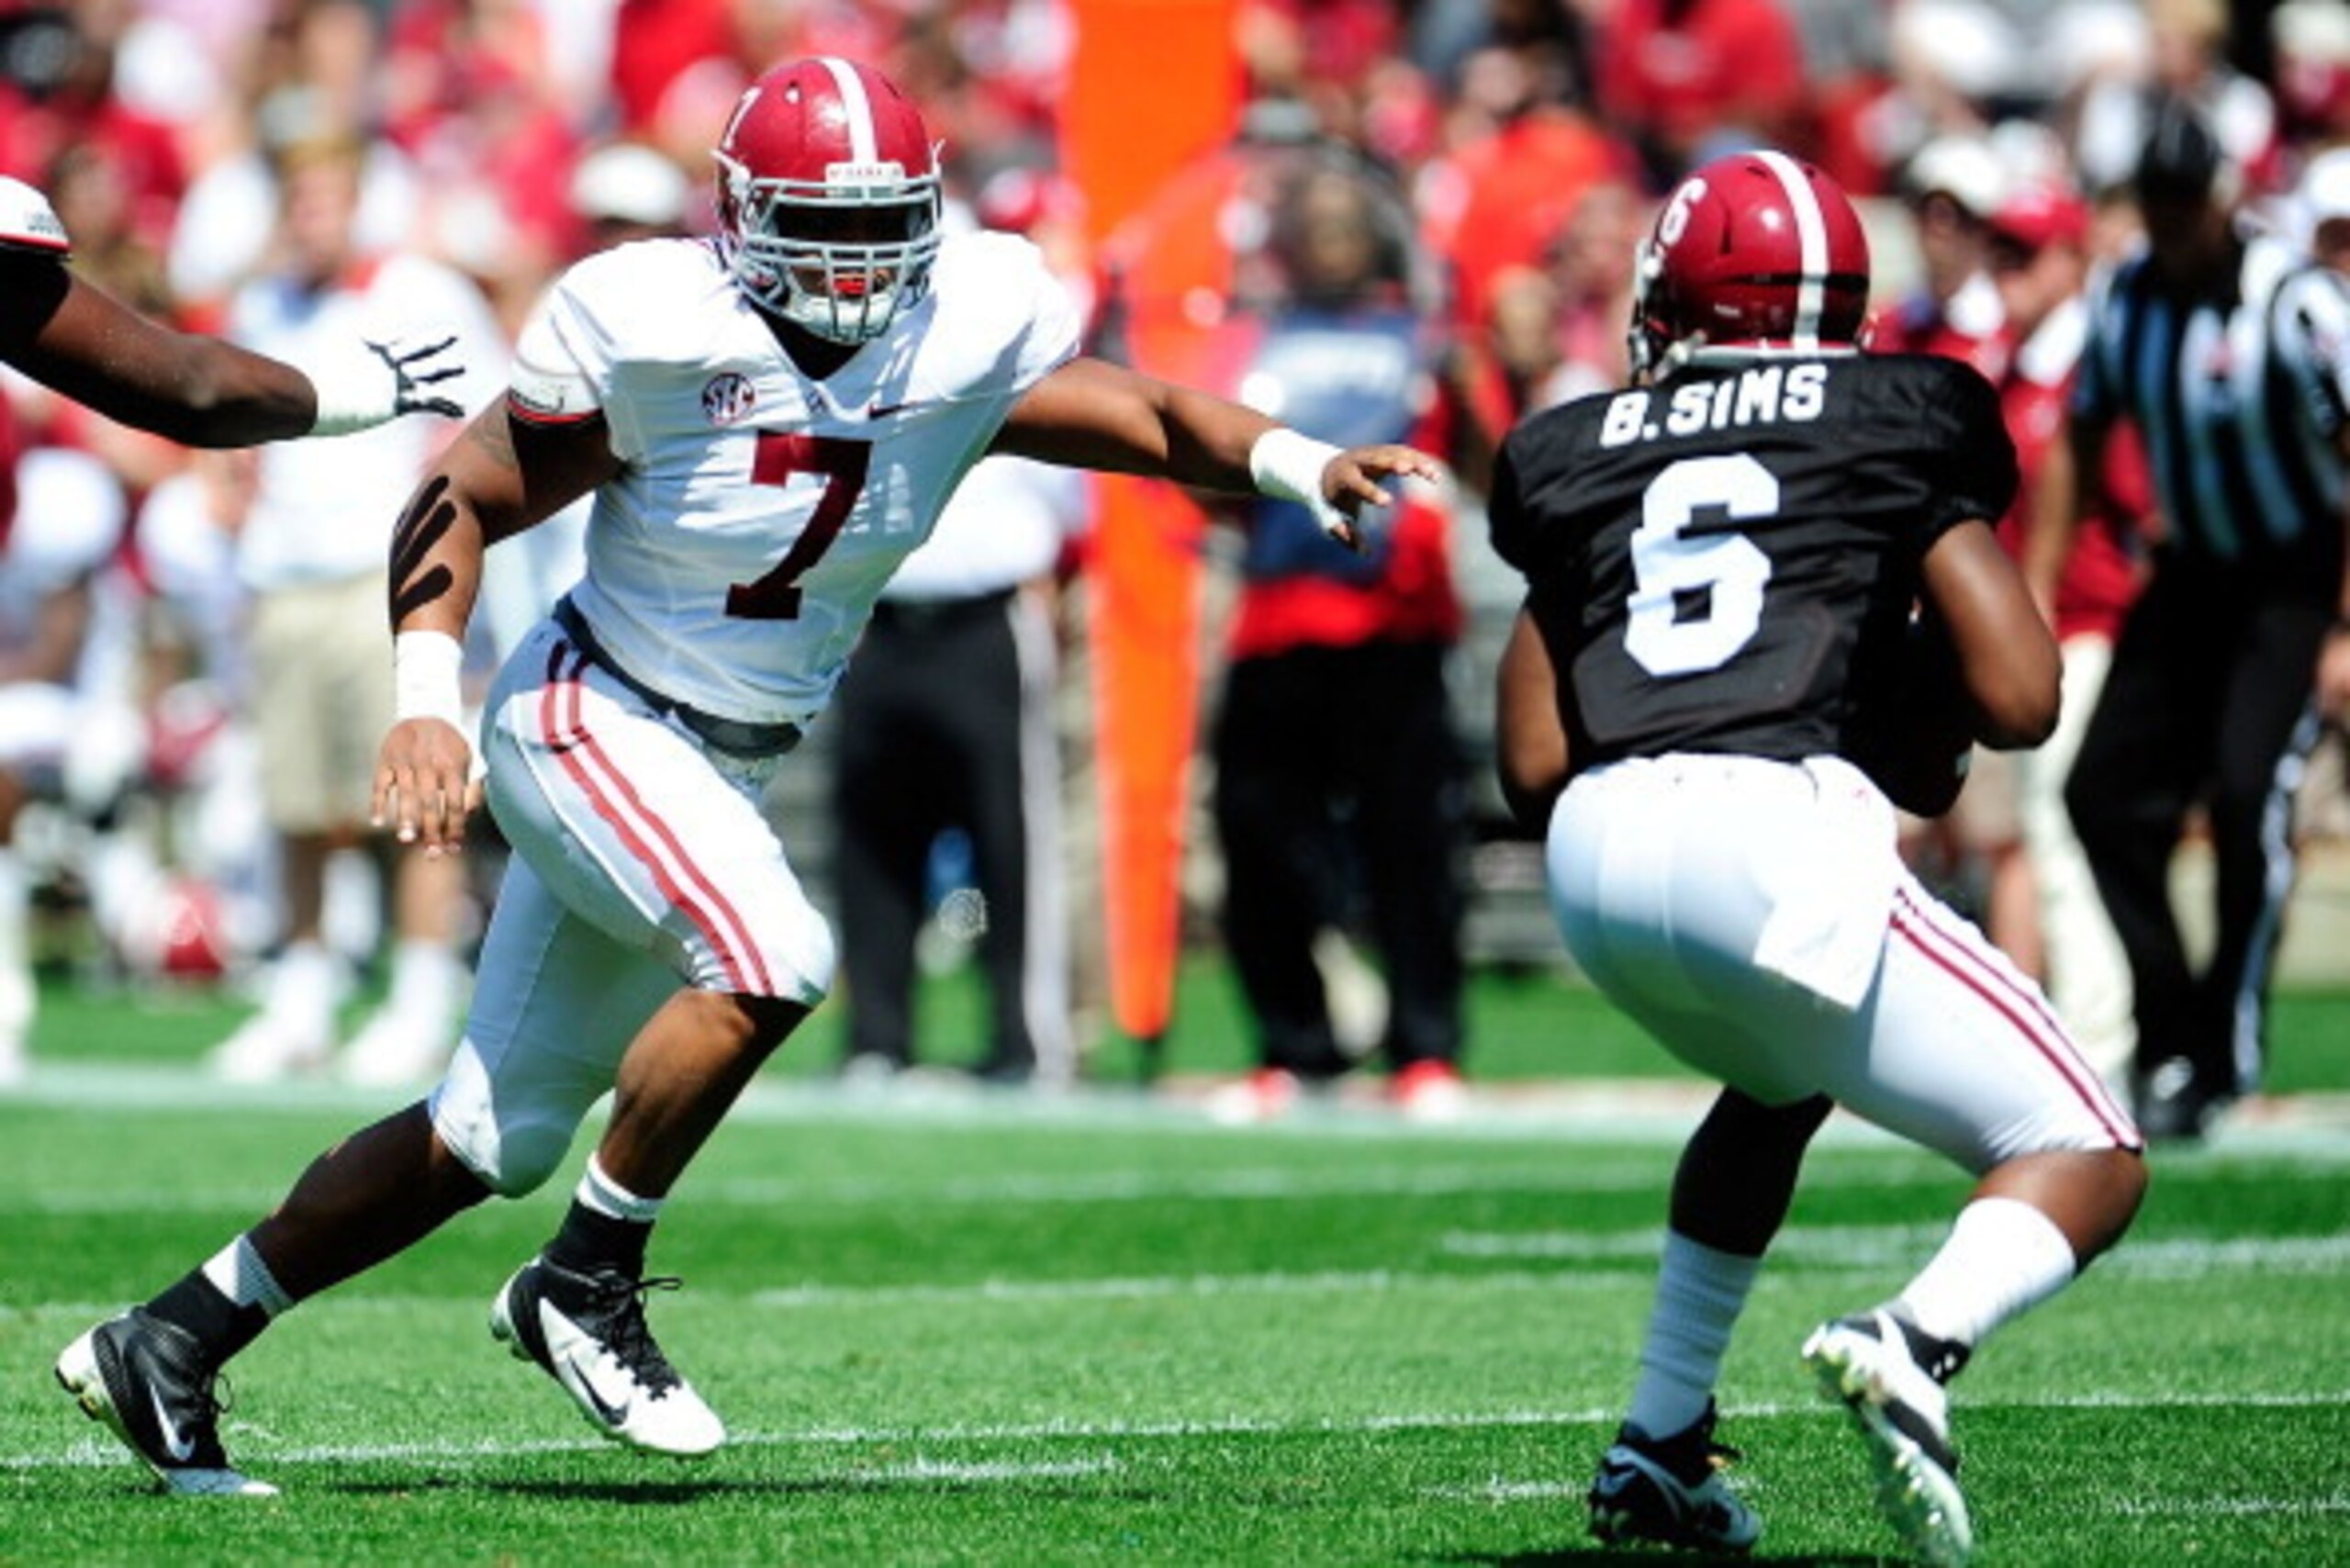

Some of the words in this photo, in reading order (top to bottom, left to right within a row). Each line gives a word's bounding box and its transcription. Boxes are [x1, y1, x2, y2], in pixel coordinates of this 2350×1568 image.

[1659, 177, 1707, 247] 6
[725, 429, 874, 620] 7
[1624, 453, 1780, 678] 6
